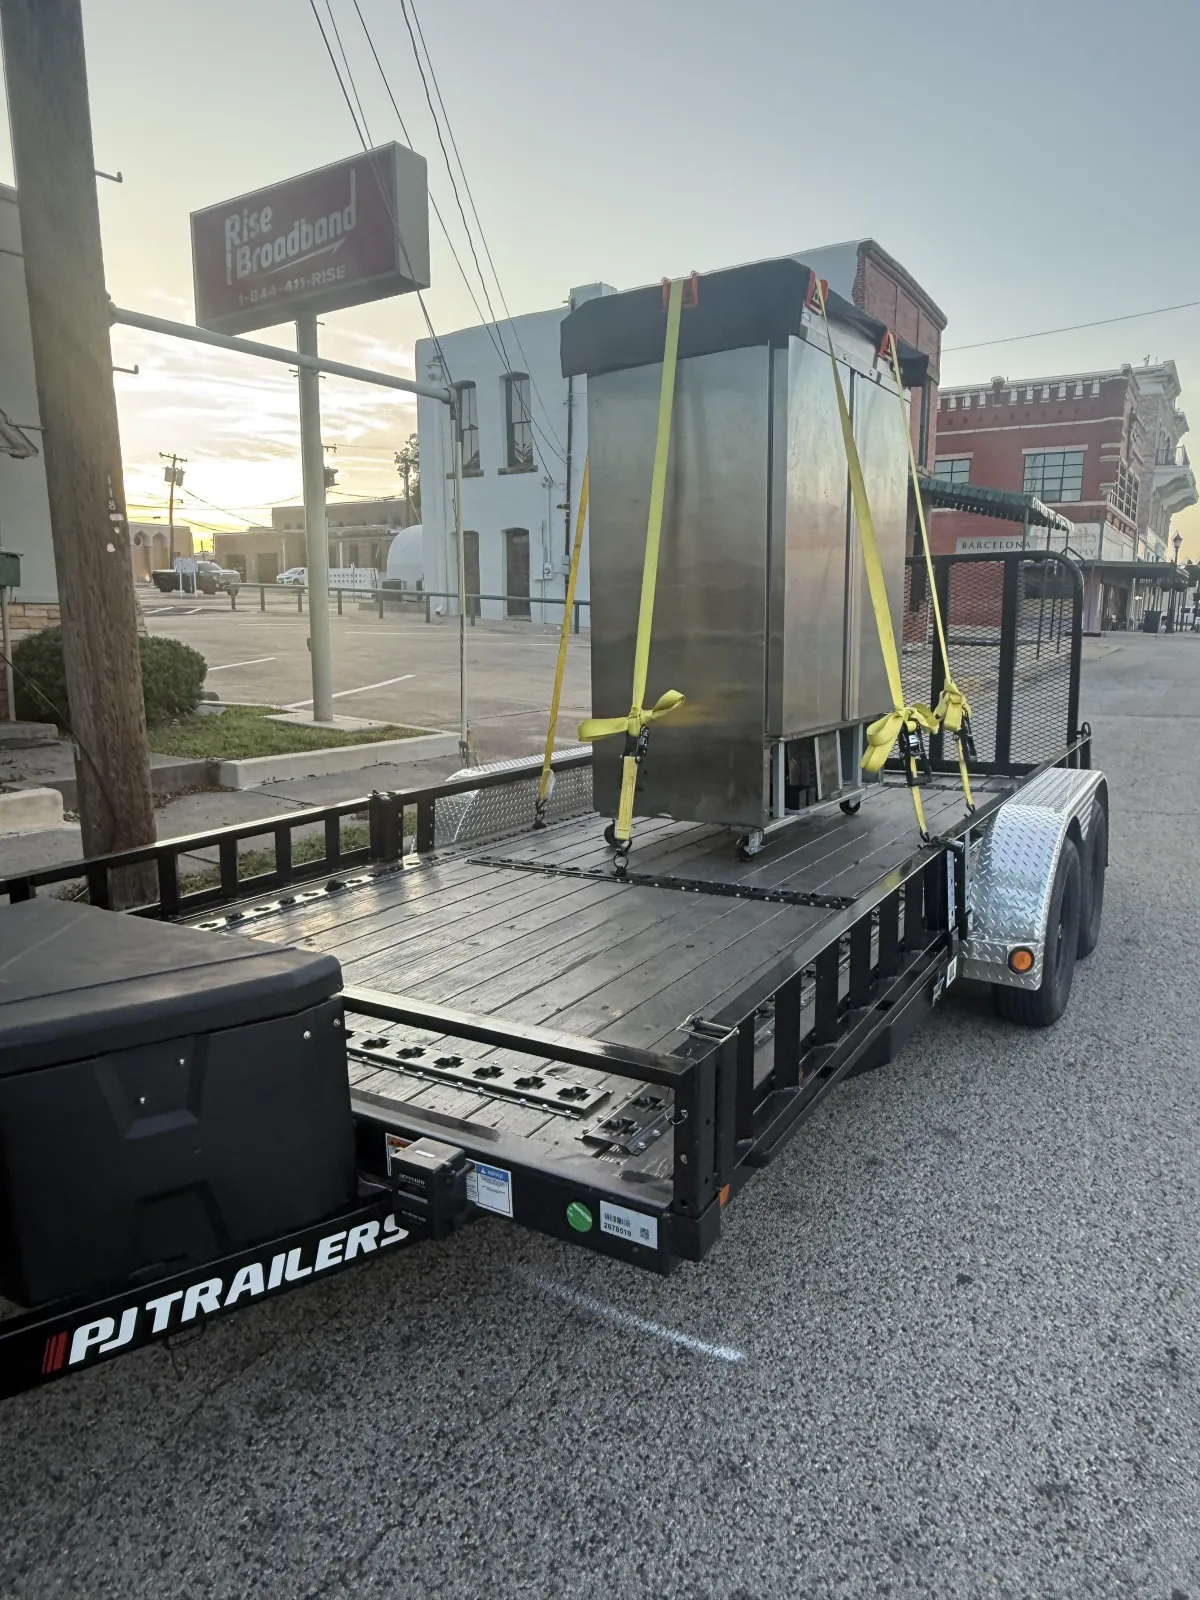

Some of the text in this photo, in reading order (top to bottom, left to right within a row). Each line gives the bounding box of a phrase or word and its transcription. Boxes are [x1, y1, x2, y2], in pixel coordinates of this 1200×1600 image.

[236, 168, 356, 280] Broadband
[238, 264, 347, 306] 1-844-411-RISE
[961, 541, 1031, 549] BARCELONA
[68, 1214, 410, 1365] PJ TRAILERS
